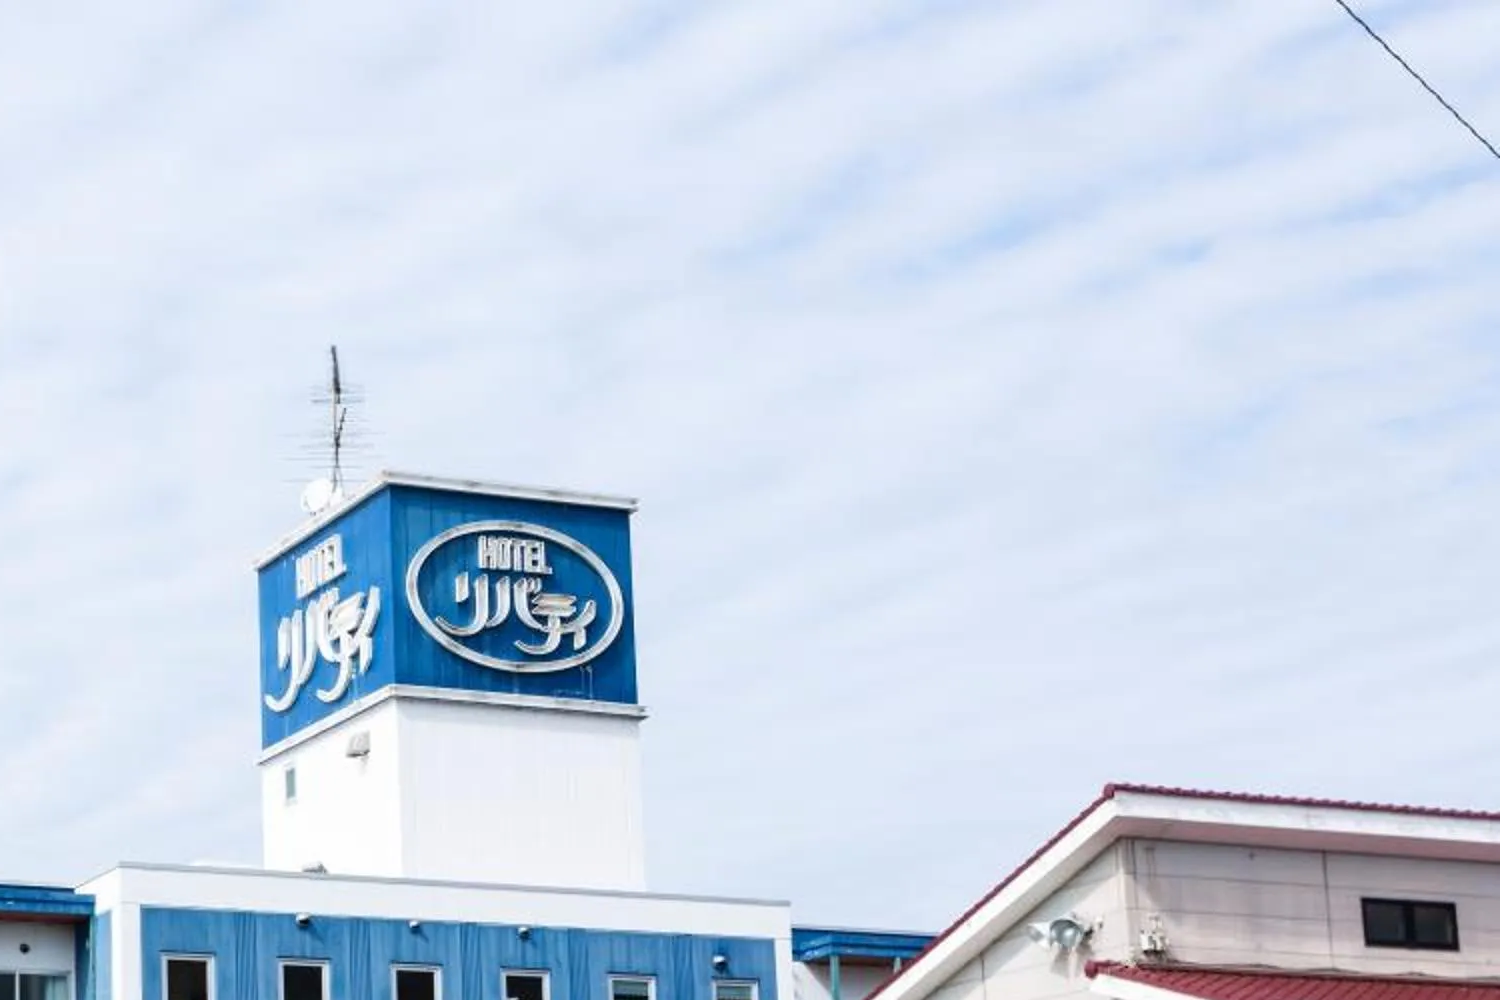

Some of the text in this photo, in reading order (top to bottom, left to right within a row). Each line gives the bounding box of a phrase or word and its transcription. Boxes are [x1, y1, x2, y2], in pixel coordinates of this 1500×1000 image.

[295, 533, 347, 600] HOTEL
[477, 534, 553, 575] HOTEL
[264, 585, 381, 712] リバティ
[435, 571, 597, 656] リバティ
